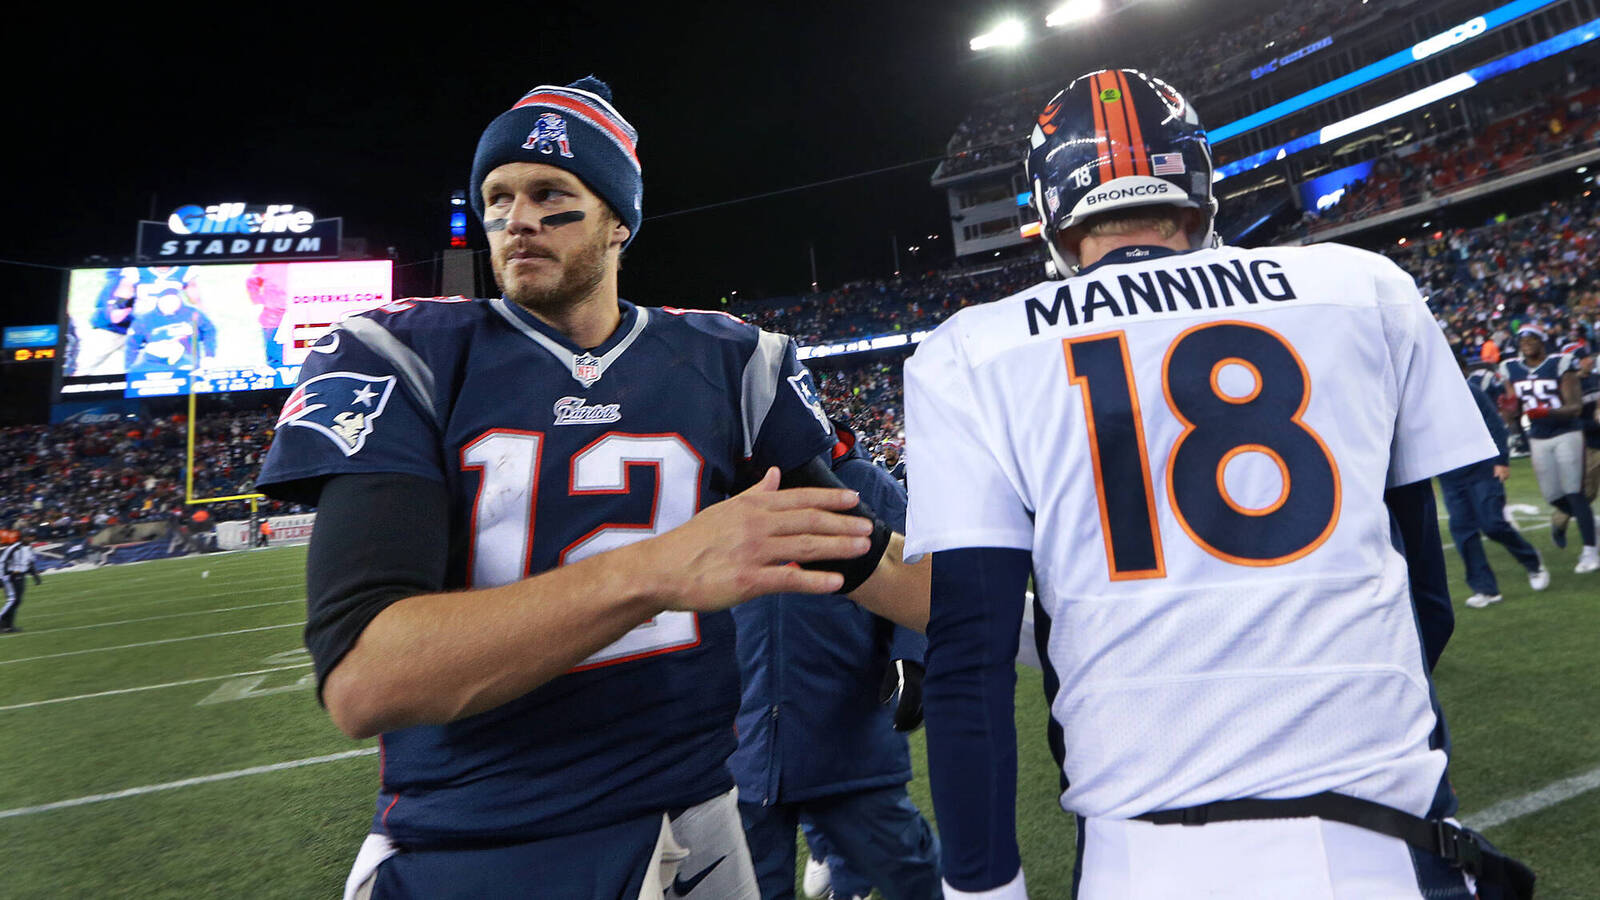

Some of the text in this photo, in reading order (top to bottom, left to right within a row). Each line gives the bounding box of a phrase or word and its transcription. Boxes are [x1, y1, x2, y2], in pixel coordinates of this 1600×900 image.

[1086, 183, 1169, 206] BRONCOS
[168, 202, 315, 235] Gillette
[159, 237, 321, 256] STADIUM
[1024, 259, 1298, 337] MANNING
[576, 365, 599, 379] NFL
[1513, 379, 1563, 411] 55
[1062, 319, 1343, 583] 18
[459, 427, 705, 674] 12
